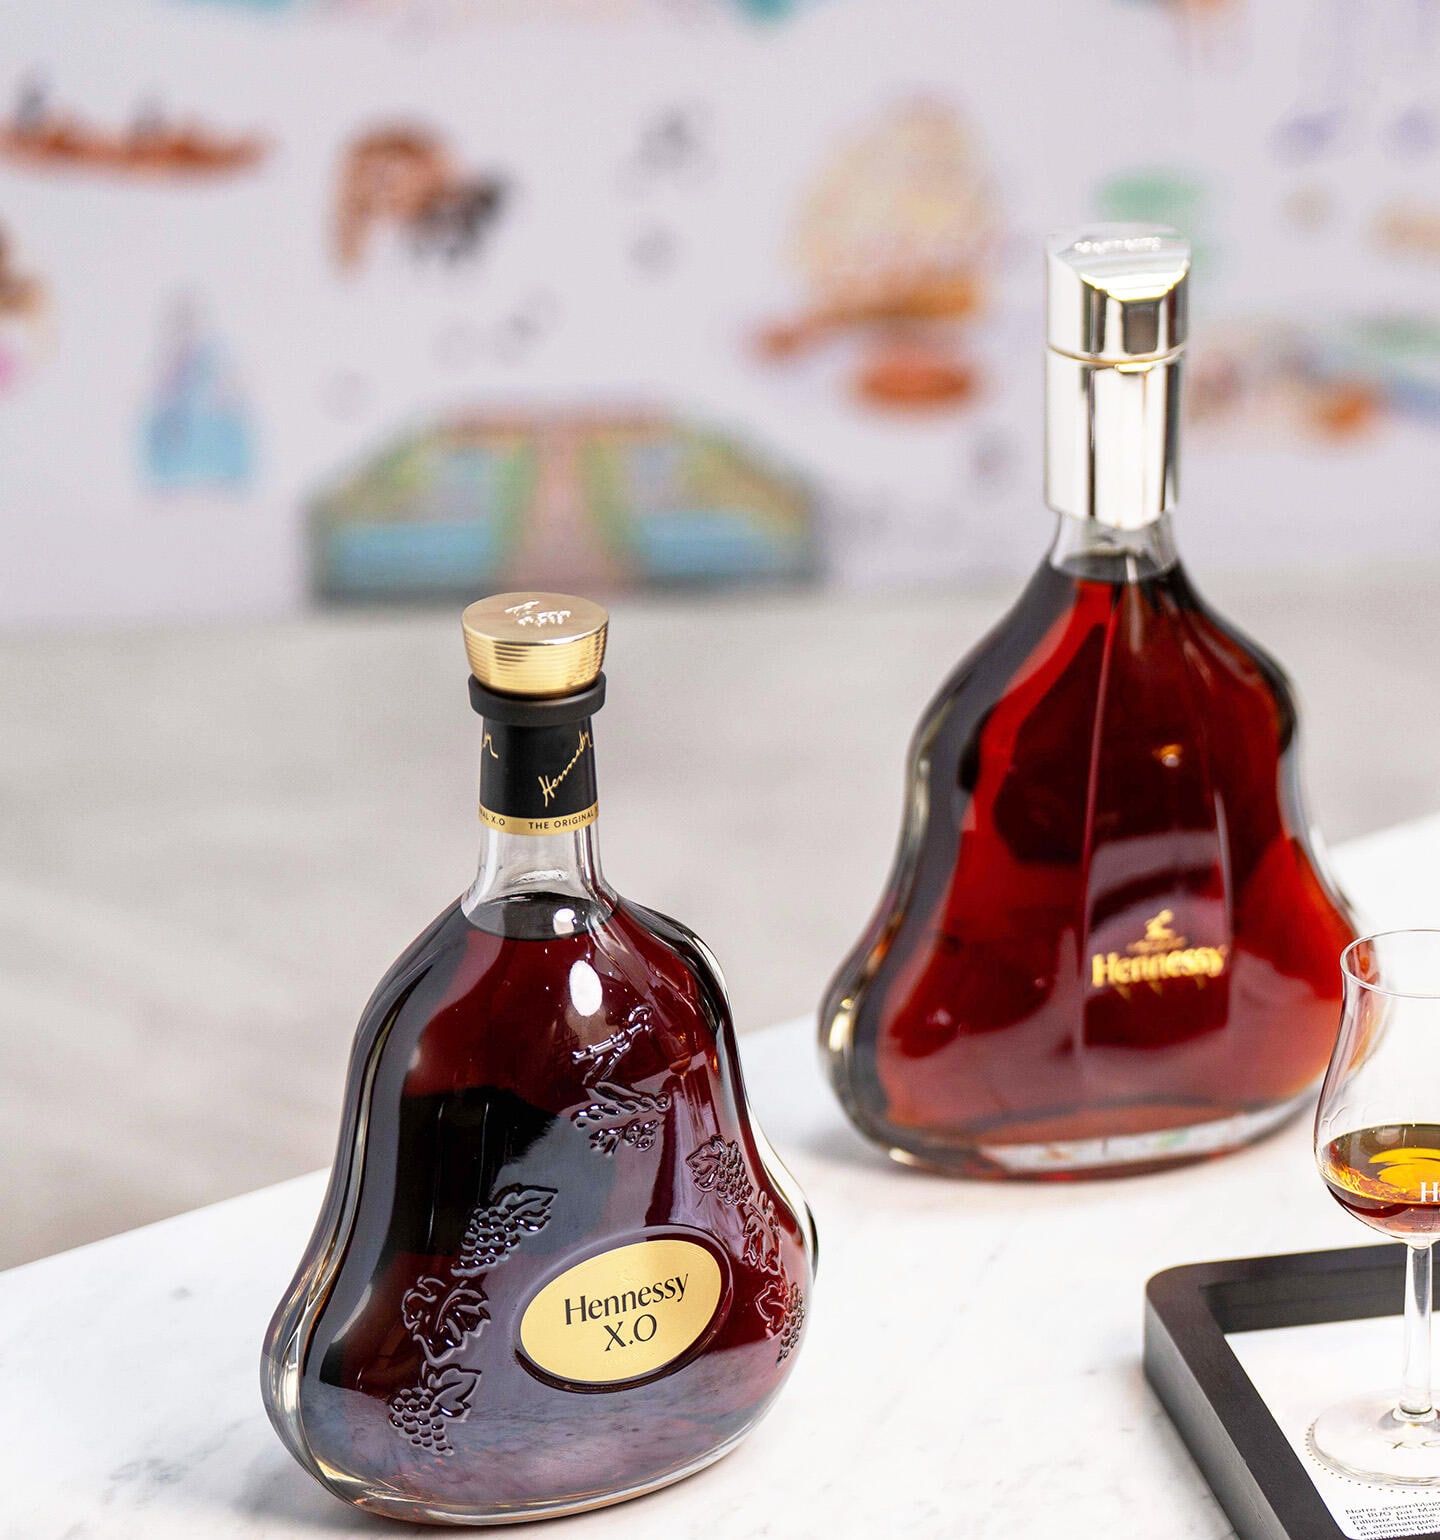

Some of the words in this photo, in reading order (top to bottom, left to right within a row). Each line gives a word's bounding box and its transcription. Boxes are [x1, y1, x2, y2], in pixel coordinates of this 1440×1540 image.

[528, 821, 549, 830] THE
[553, 809, 594, 829] ORIGINAL
[564, 1273, 689, 1326] Hennessy
[603, 1313, 658, 1352] X.O
[1360, 1527, 1414, 1536] anciennes
